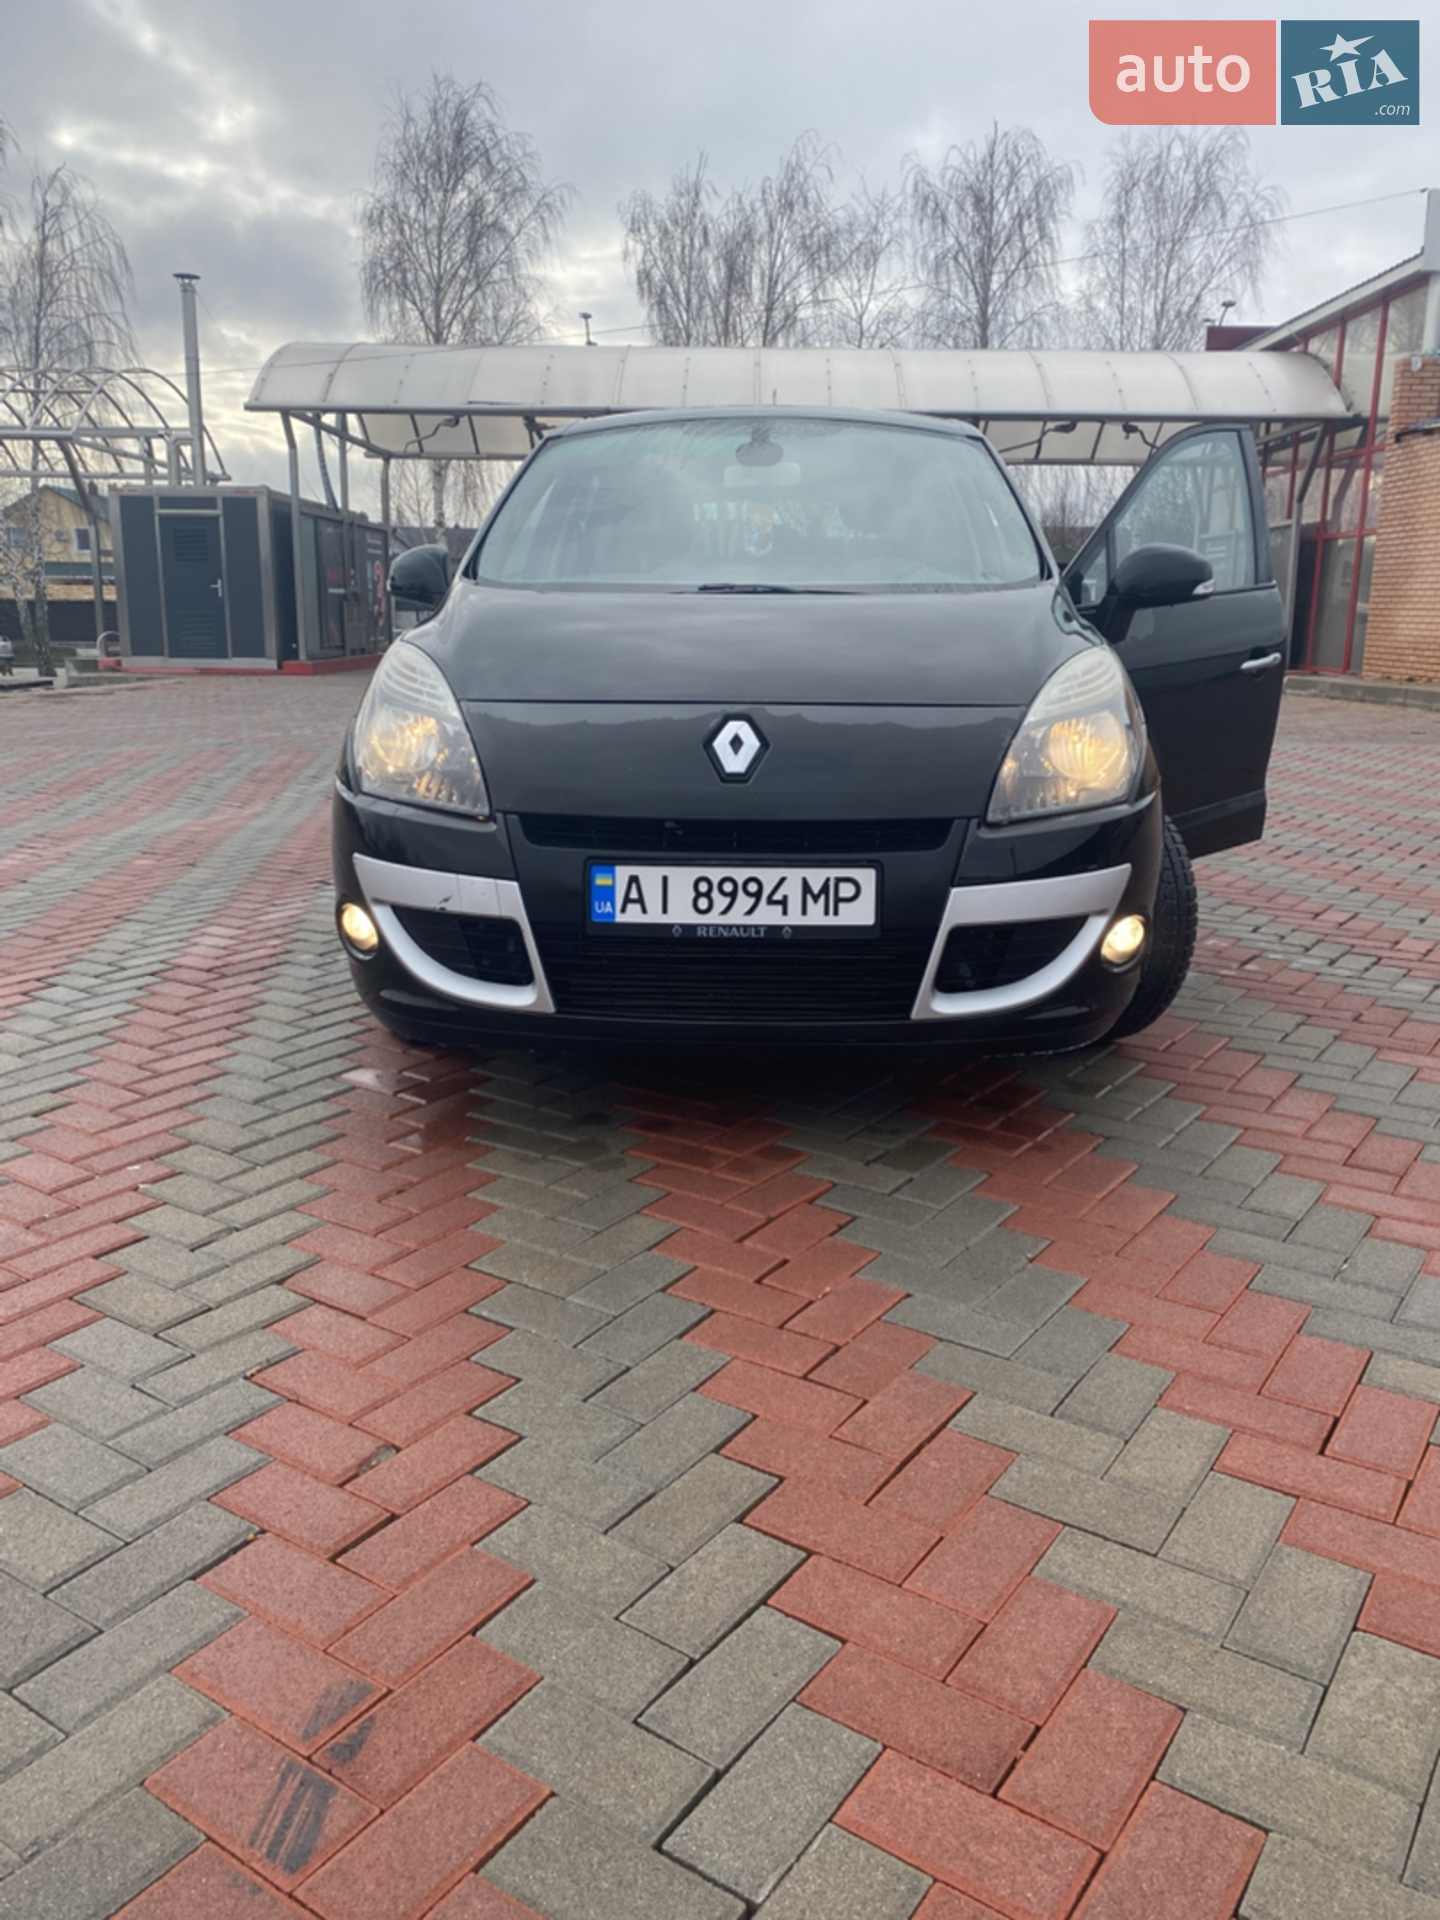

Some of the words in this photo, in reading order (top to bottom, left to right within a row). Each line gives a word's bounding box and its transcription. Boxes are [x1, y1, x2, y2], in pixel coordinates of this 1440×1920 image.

[619, 874, 669, 915] AI
[691, 876, 789, 917] 8994
[801, 876, 862, 917] MP
[595, 902, 613, 914] UA
[696, 925, 768, 938] RENAULT
